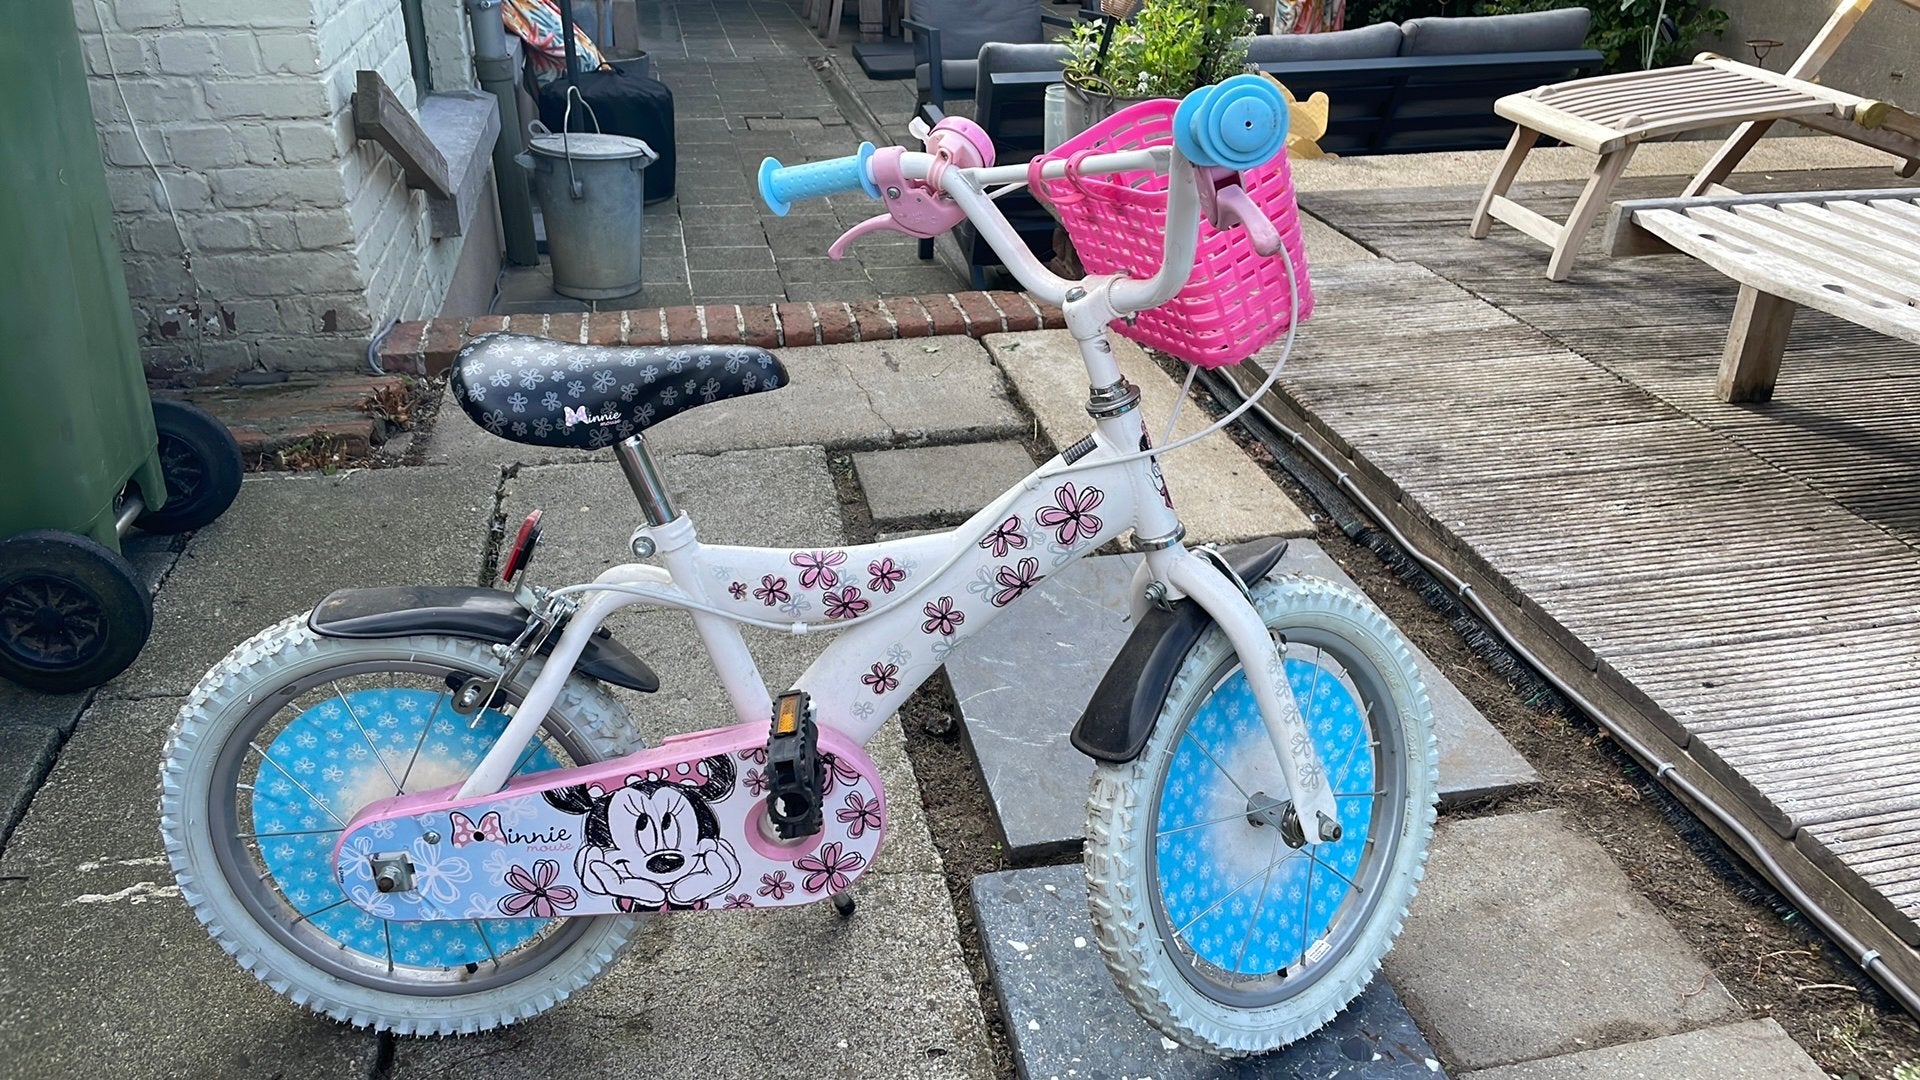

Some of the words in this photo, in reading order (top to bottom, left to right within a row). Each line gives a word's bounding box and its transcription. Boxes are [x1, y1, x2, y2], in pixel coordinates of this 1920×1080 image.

[564, 406, 621, 426] Minnie
[450, 811, 572, 848] Minnie
[527, 841, 573, 853] mouse
